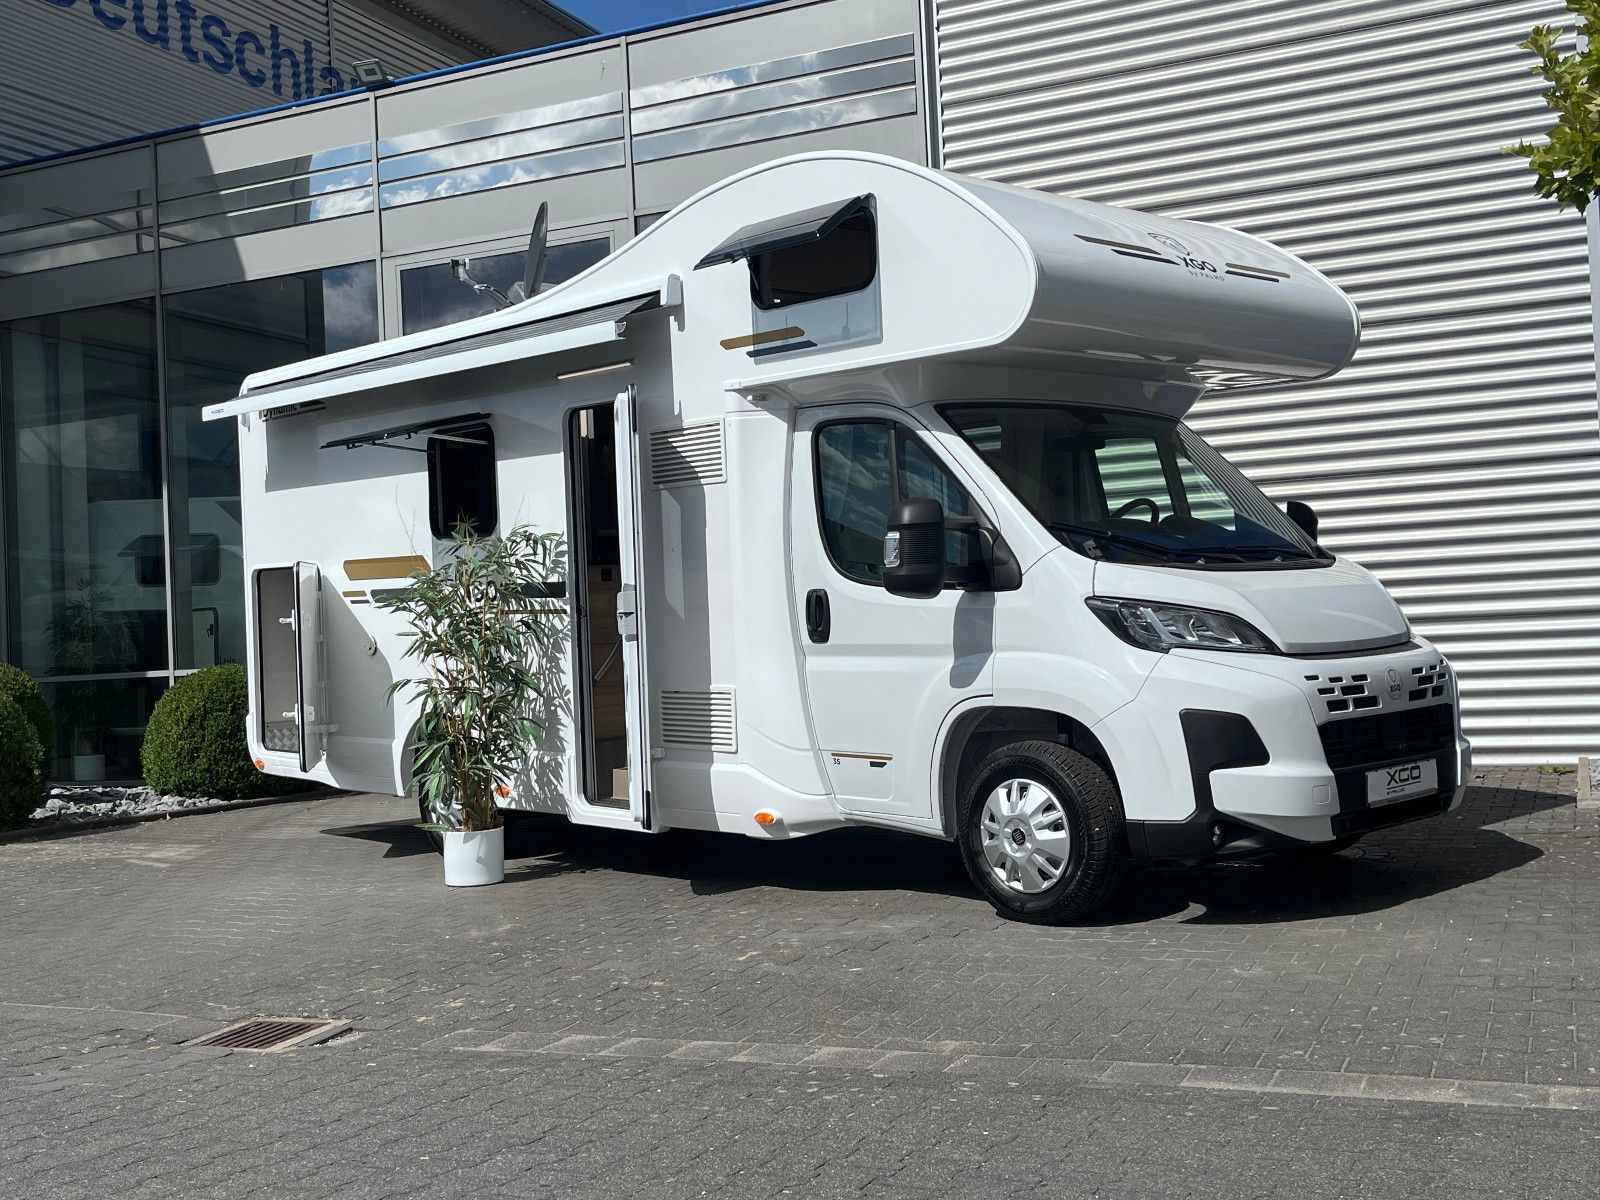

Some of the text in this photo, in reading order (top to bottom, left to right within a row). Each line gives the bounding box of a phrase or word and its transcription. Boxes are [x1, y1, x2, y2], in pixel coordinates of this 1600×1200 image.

[1176, 255, 1217, 273] XGO
[832, 757, 841, 765] 35
[1386, 764, 1421, 787] XGO
